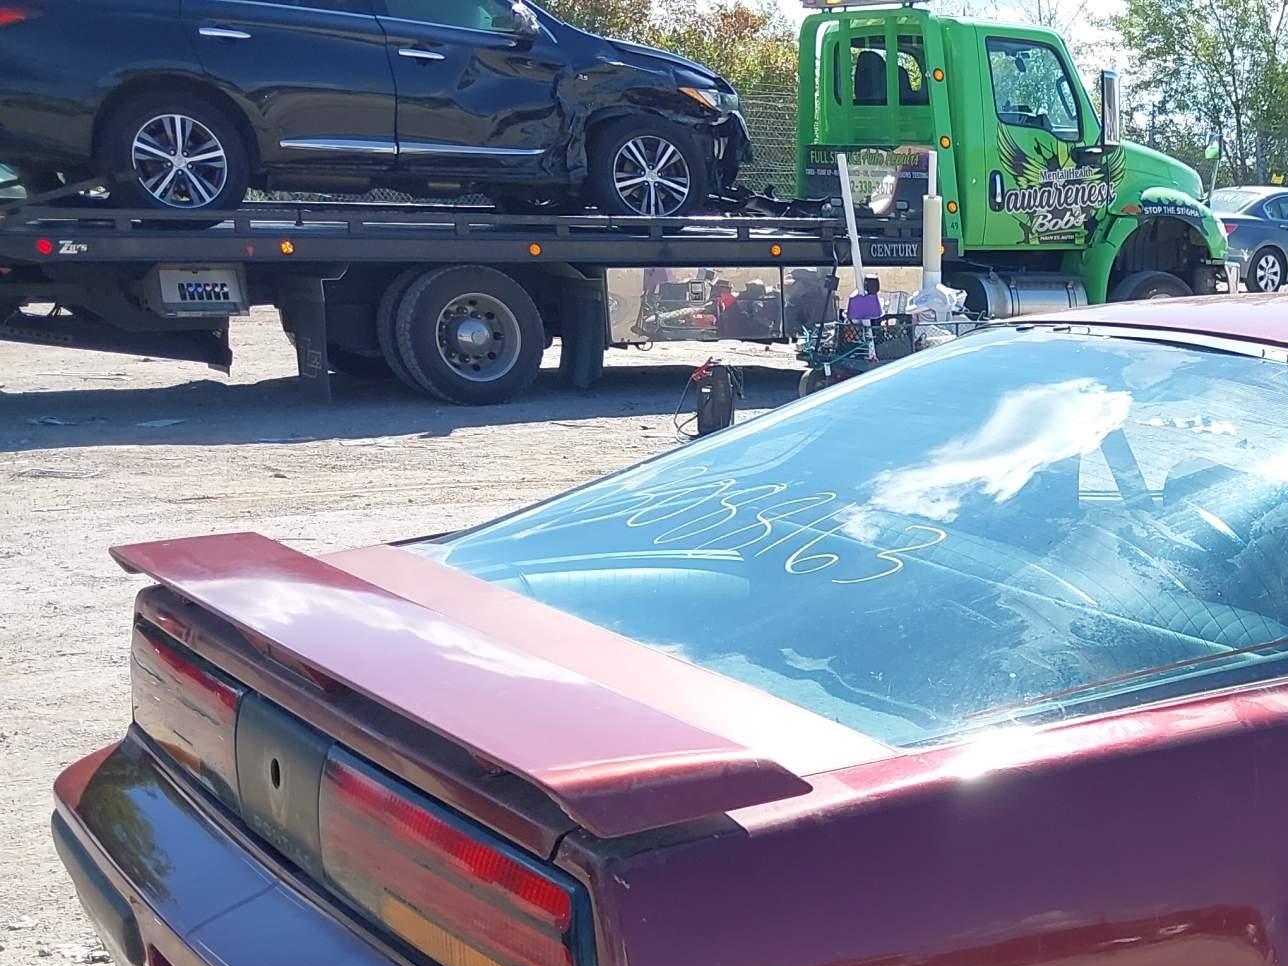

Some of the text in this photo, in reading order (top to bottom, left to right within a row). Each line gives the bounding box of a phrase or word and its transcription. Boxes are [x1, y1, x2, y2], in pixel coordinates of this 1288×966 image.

[810, 151, 830, 164] FULL
[1039, 166, 1094, 182] Mental Health
[1005, 181, 1117, 214] awareness
[1144, 206, 1200, 218] STOP THE STIGMA
[1032, 210, 1088, 234] Bob's
[871, 243, 918, 257] CENTURY
